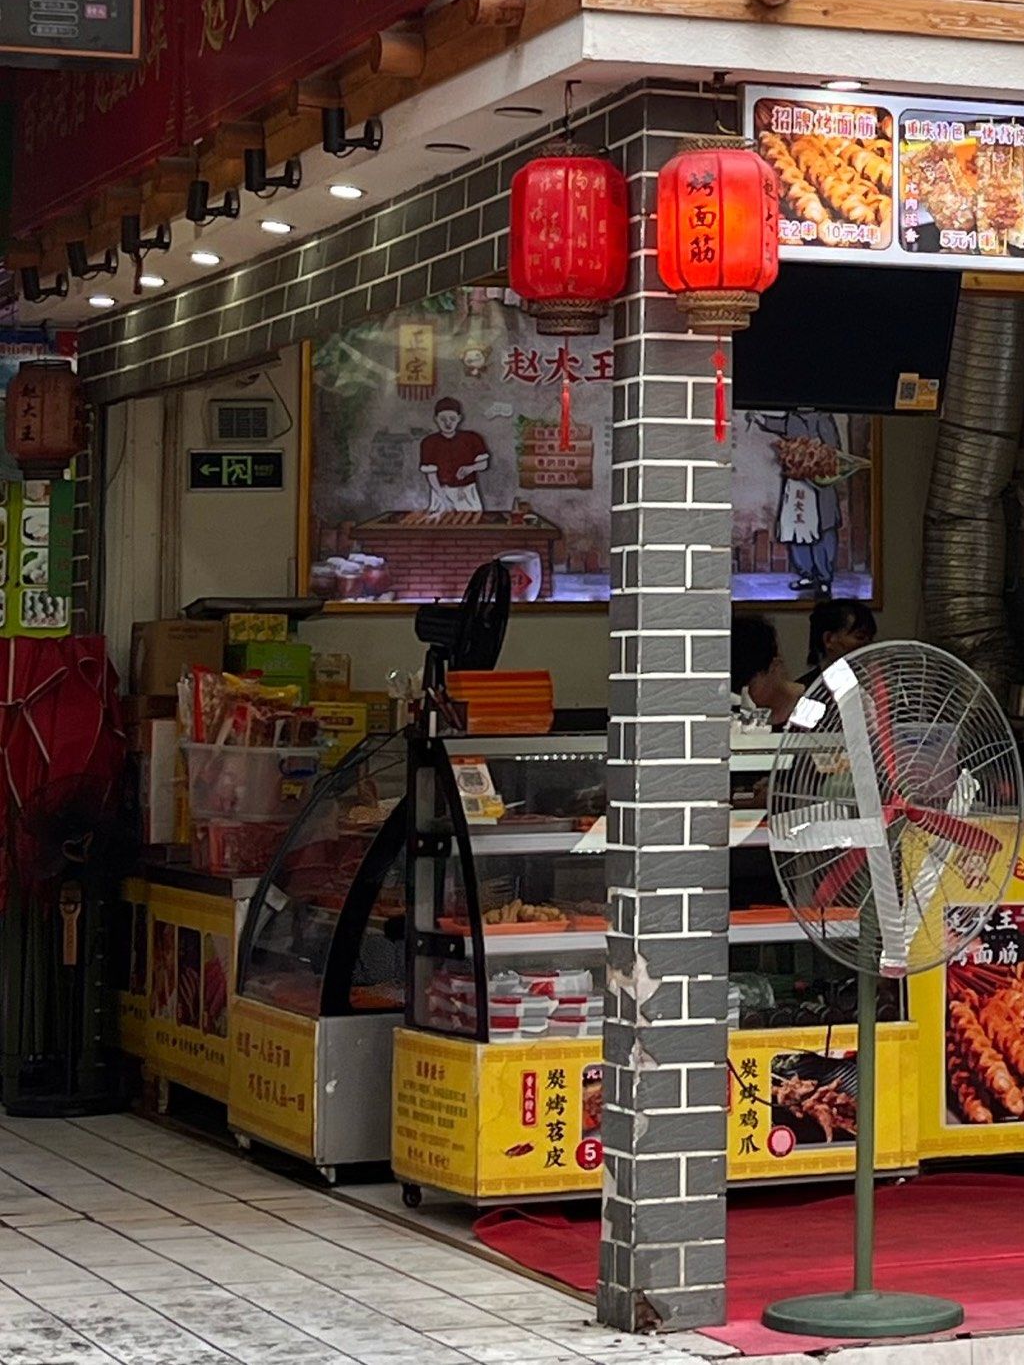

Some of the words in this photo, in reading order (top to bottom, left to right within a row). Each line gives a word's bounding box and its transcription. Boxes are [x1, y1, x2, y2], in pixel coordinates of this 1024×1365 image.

[771, 106, 877, 139] 招牌烤面筋
[687, 171, 717, 265] 烤面筋
[940, 231, 998, 252] 5元1串
[404, 325, 431, 387] 正宗
[502, 345, 613, 384] 赵大王
[544, 1068, 568, 1169] 炭烤苕皮
[738, 1057, 761, 1156] 炭烤鸡爪
[584, 1143, 598, 1162] 5
